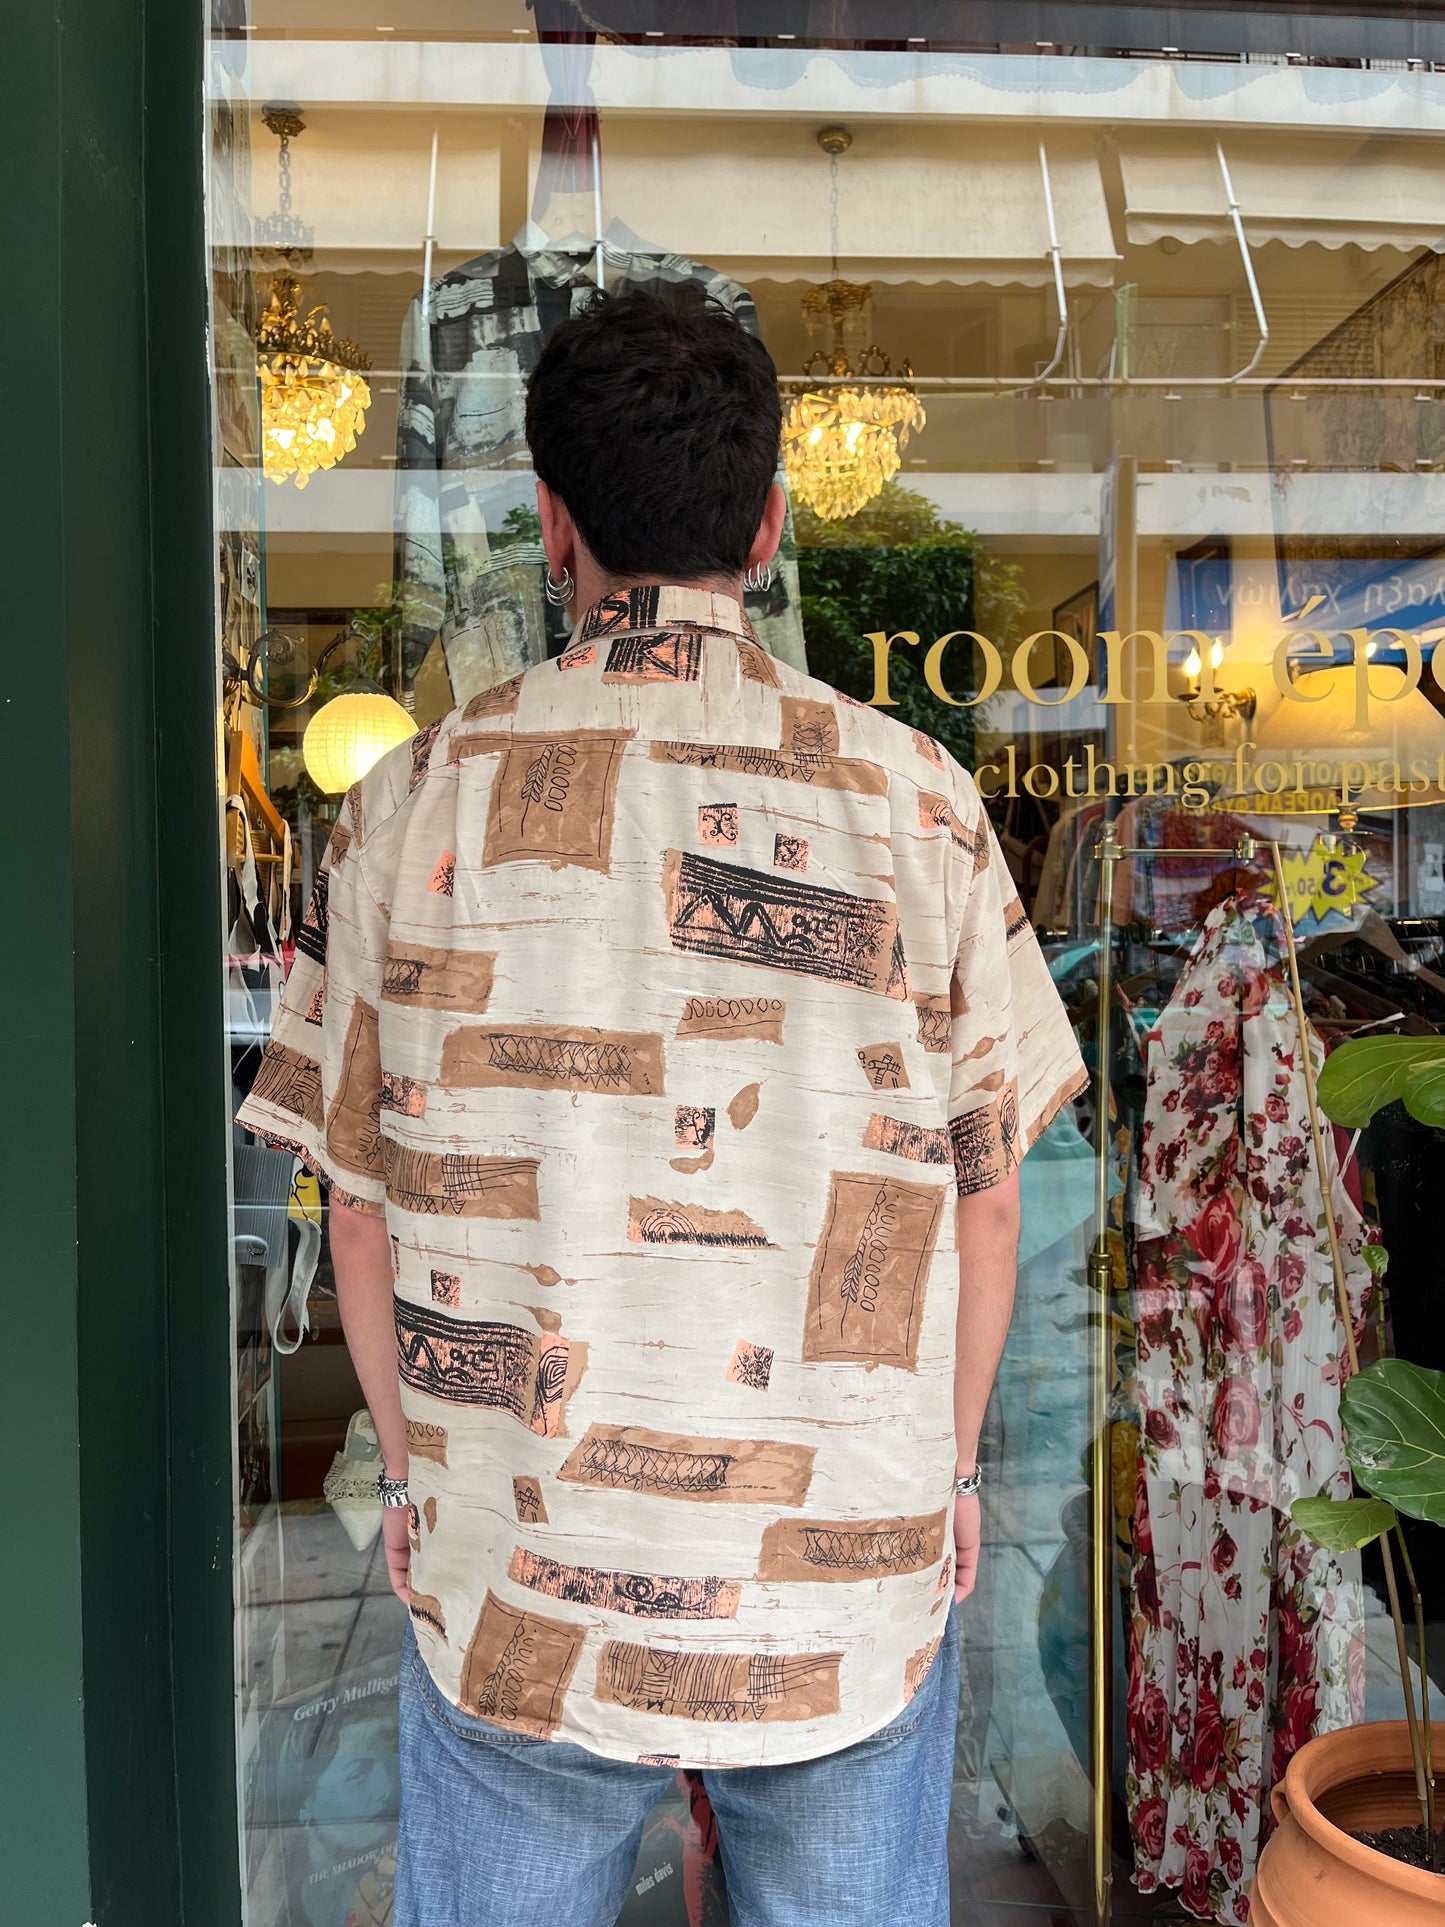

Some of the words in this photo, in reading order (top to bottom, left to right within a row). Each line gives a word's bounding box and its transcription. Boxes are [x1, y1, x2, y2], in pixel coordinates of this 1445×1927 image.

[862, 630, 1220, 707] room
[1272, 595, 1445, 732] ép
[974, 744, 1212, 808] clothing
[1234, 742, 1315, 798] for
[293, 1695, 340, 1721] Gerry
